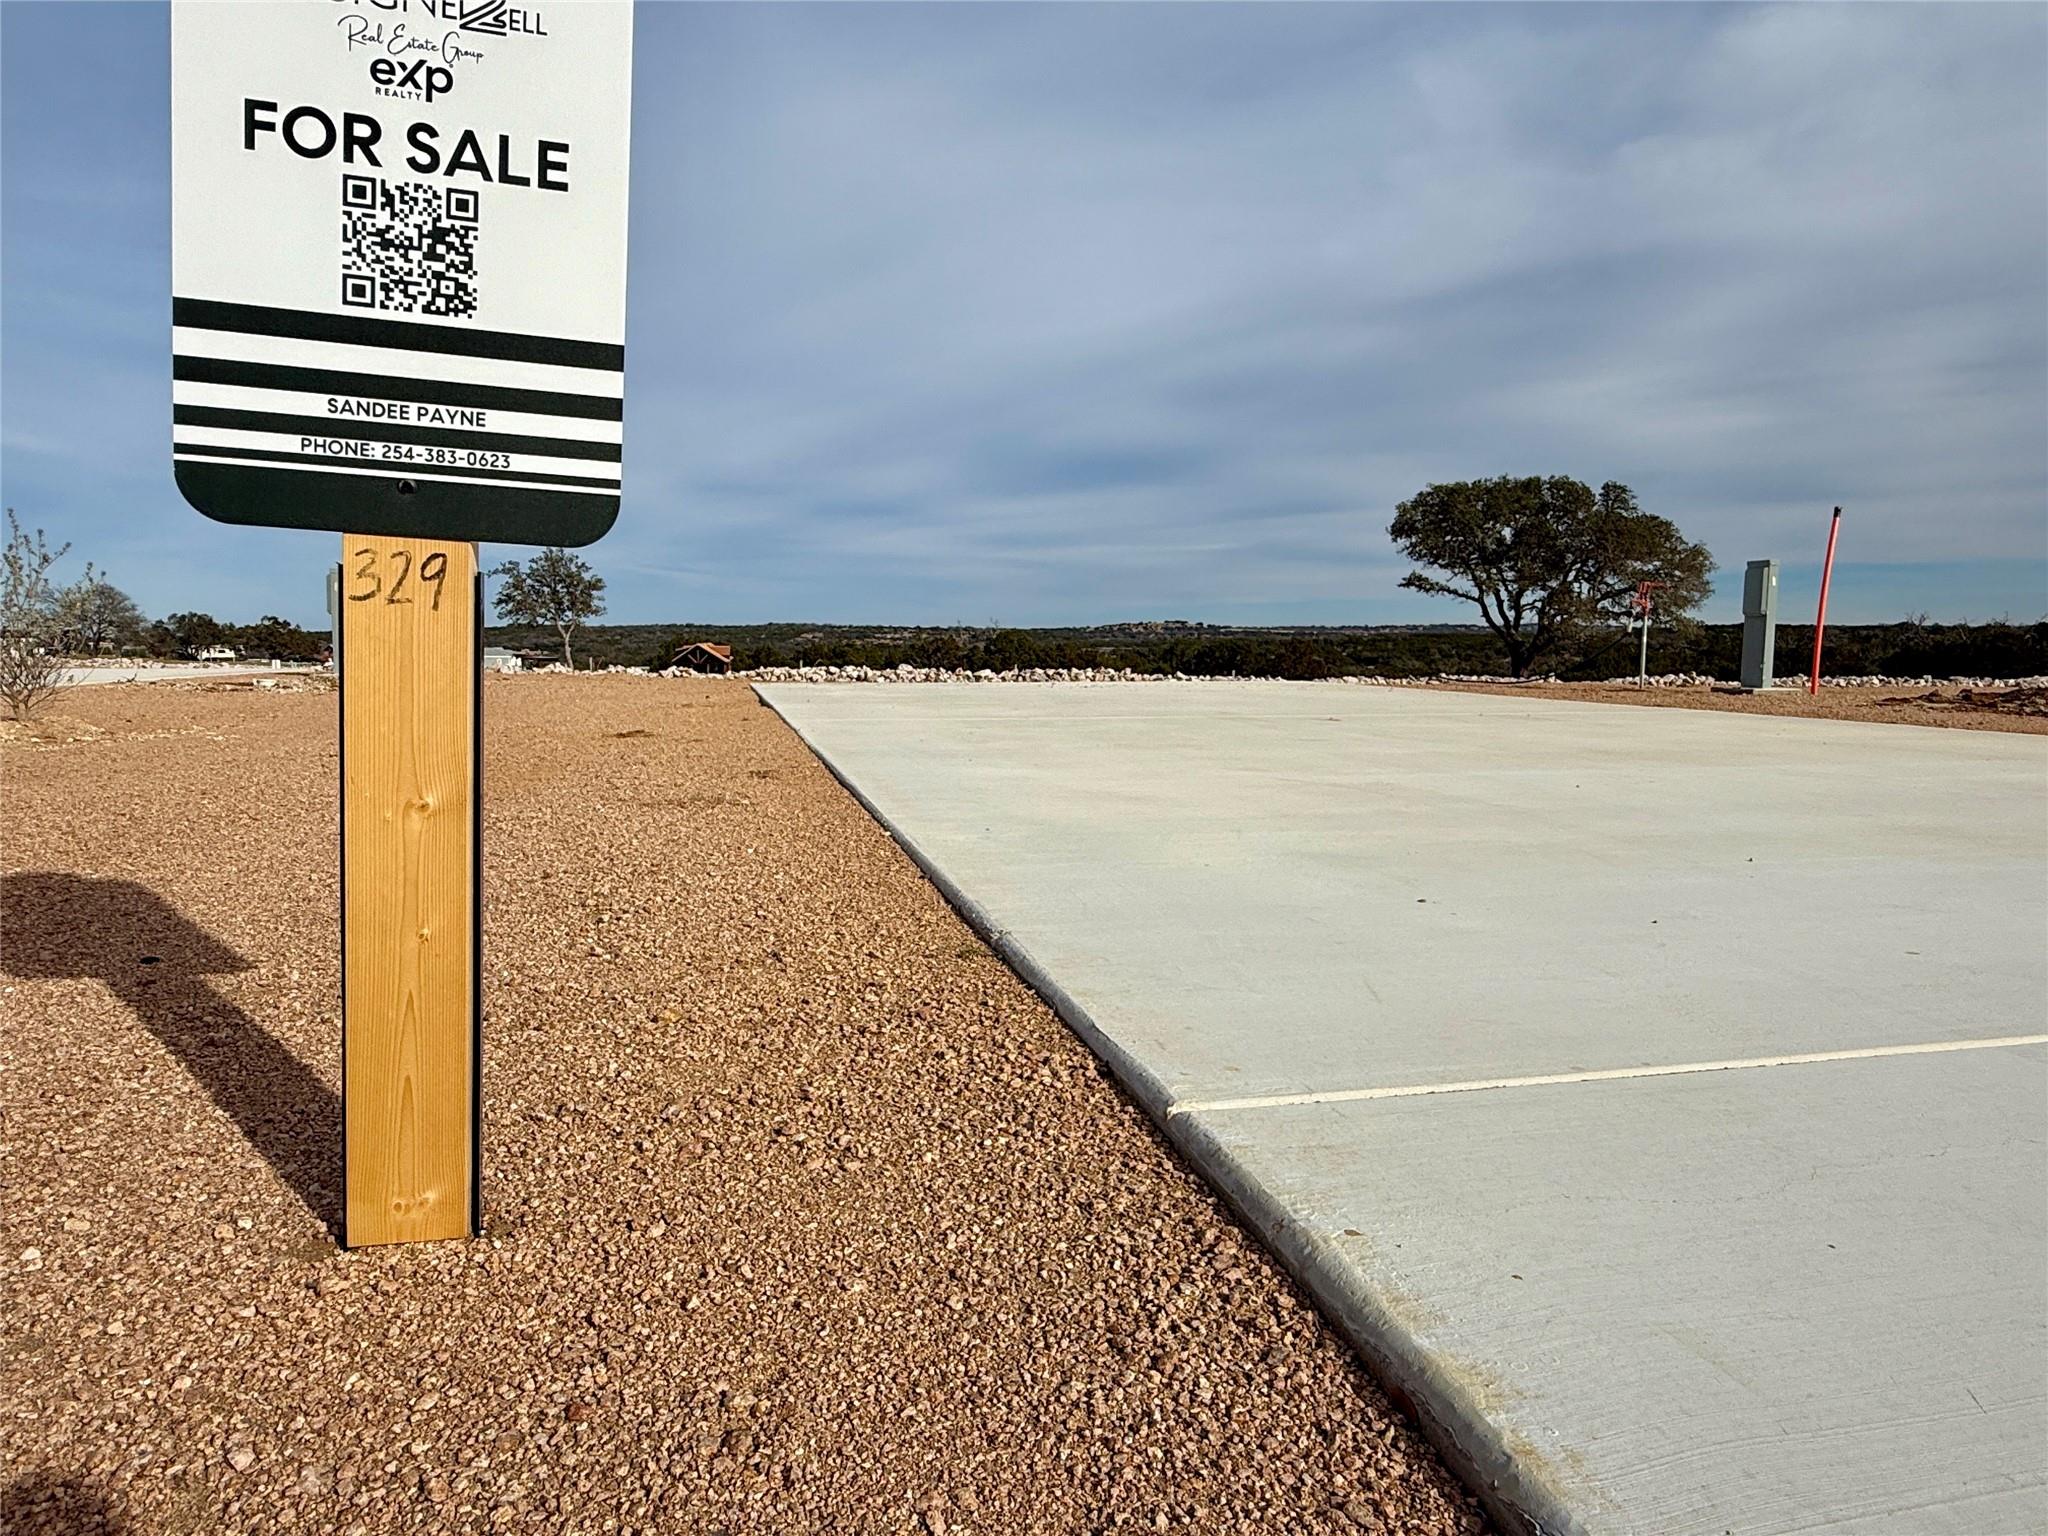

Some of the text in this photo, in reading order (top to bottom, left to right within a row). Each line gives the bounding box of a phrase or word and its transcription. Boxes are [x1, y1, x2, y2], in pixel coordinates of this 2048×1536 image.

[338, 15, 484, 64] Real Estate Group
[375, 87, 422, 101] REALTY
[244, 98, 570, 192] FOR SALE
[327, 398, 486, 427] SANDEE PAYNE
[301, 437, 510, 468] PHONE: 254-383-0623
[348, 549, 448, 611] 329
